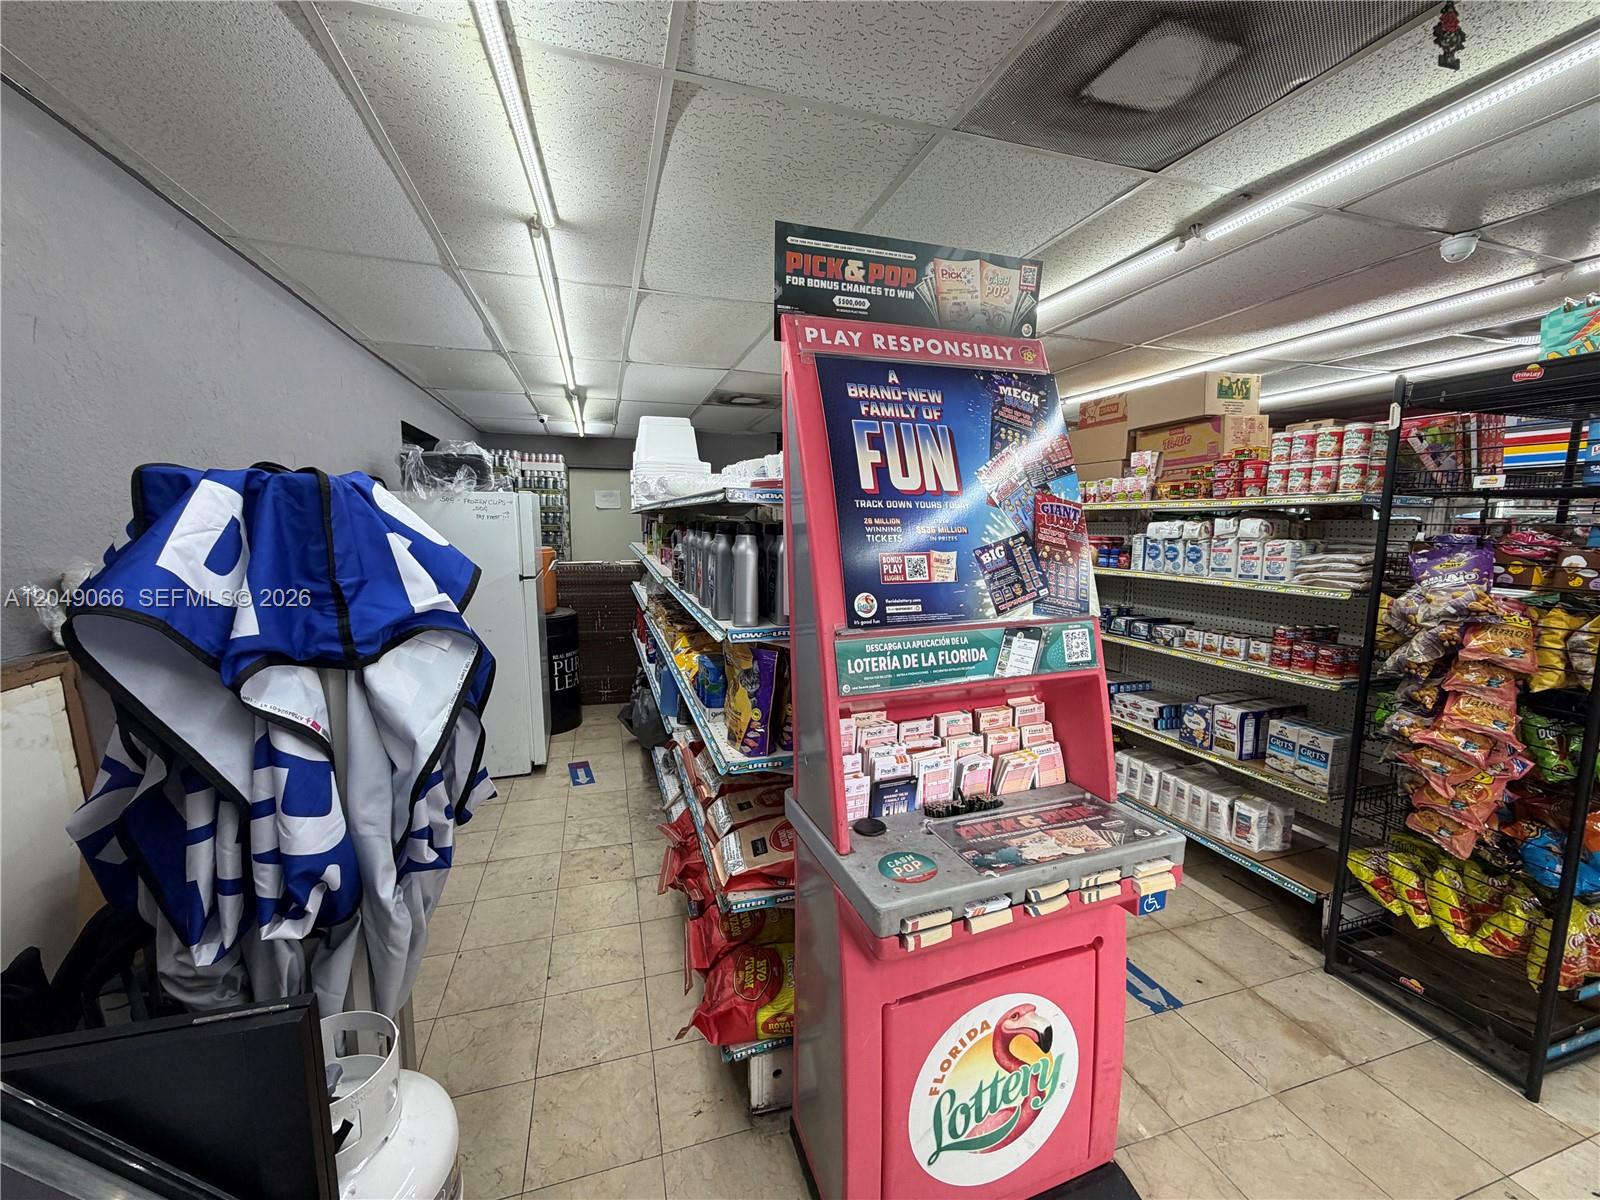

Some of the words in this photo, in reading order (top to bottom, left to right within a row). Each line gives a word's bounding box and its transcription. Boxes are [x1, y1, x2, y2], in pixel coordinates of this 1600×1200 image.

[785, 251, 844, 281] PICK
[844, 259, 866, 283] &
[868, 262, 917, 288] POP
[786, 275, 806, 287] FOR
[807, 278, 839, 290] BONUS
[841, 282, 882, 296] CHANCES
[884, 288, 896, 297] TO
[897, 289, 915, 300] WIN
[988, 275, 1010, 285] CASH
[985, 286, 1009, 298] POP
[837, 298, 866, 307] $500,000
[804, 327, 863, 348] PLAY
[872, 333, 1014, 361] RESPONSIBLY
[888, 370, 899, 384] A
[846, 382, 943, 404] BRAND-NEW
[999, 385, 1040, 407] MEGA
[860, 401, 917, 419] FAMILY
[922, 407, 942, 420] OF
[851, 419, 962, 494] FUN
[854, 500, 885, 509] TRACK
[886, 501, 912, 509] DOWN
[915, 501, 942, 509] YOURS
[1041, 504, 1080, 521] GIANT
[864, 517, 872, 525] 28
[866, 535, 902, 543] TICKETS
[938, 527, 968, 536] MILLION
[882, 556, 902, 564] BONUS
[980, 546, 1005, 565] BIG
[883, 564, 902, 574] PLAY
[733, 631, 762, 640] NOW
[866, 643, 902, 653] DESCARGA
[912, 636, 950, 649] APLICACIÓN
[951, 637, 960, 645] DE
[960, 636, 968, 645] LA
[553, 656, 580, 676] PUR
[847, 652, 900, 674] LOTERÍA
[903, 653, 919, 669] DE
[921, 652, 937, 667] LA
[938, 647, 988, 664] FLORIDA
[554, 672, 580, 691] LEA
[1270, 736, 1296, 751] GRITS
[1299, 746, 1327, 762] GRITS
[882, 801, 908, 817] FUN
[887, 854, 915, 868] CASH
[893, 861, 923, 877] POP
[732, 900, 766, 910] LATER
[744, 956, 755, 989] ROYAL
[756, 959, 767, 981] OAK
[928, 1019, 992, 1097] FLORIDA
[927, 1052, 1064, 1166] Lottery
